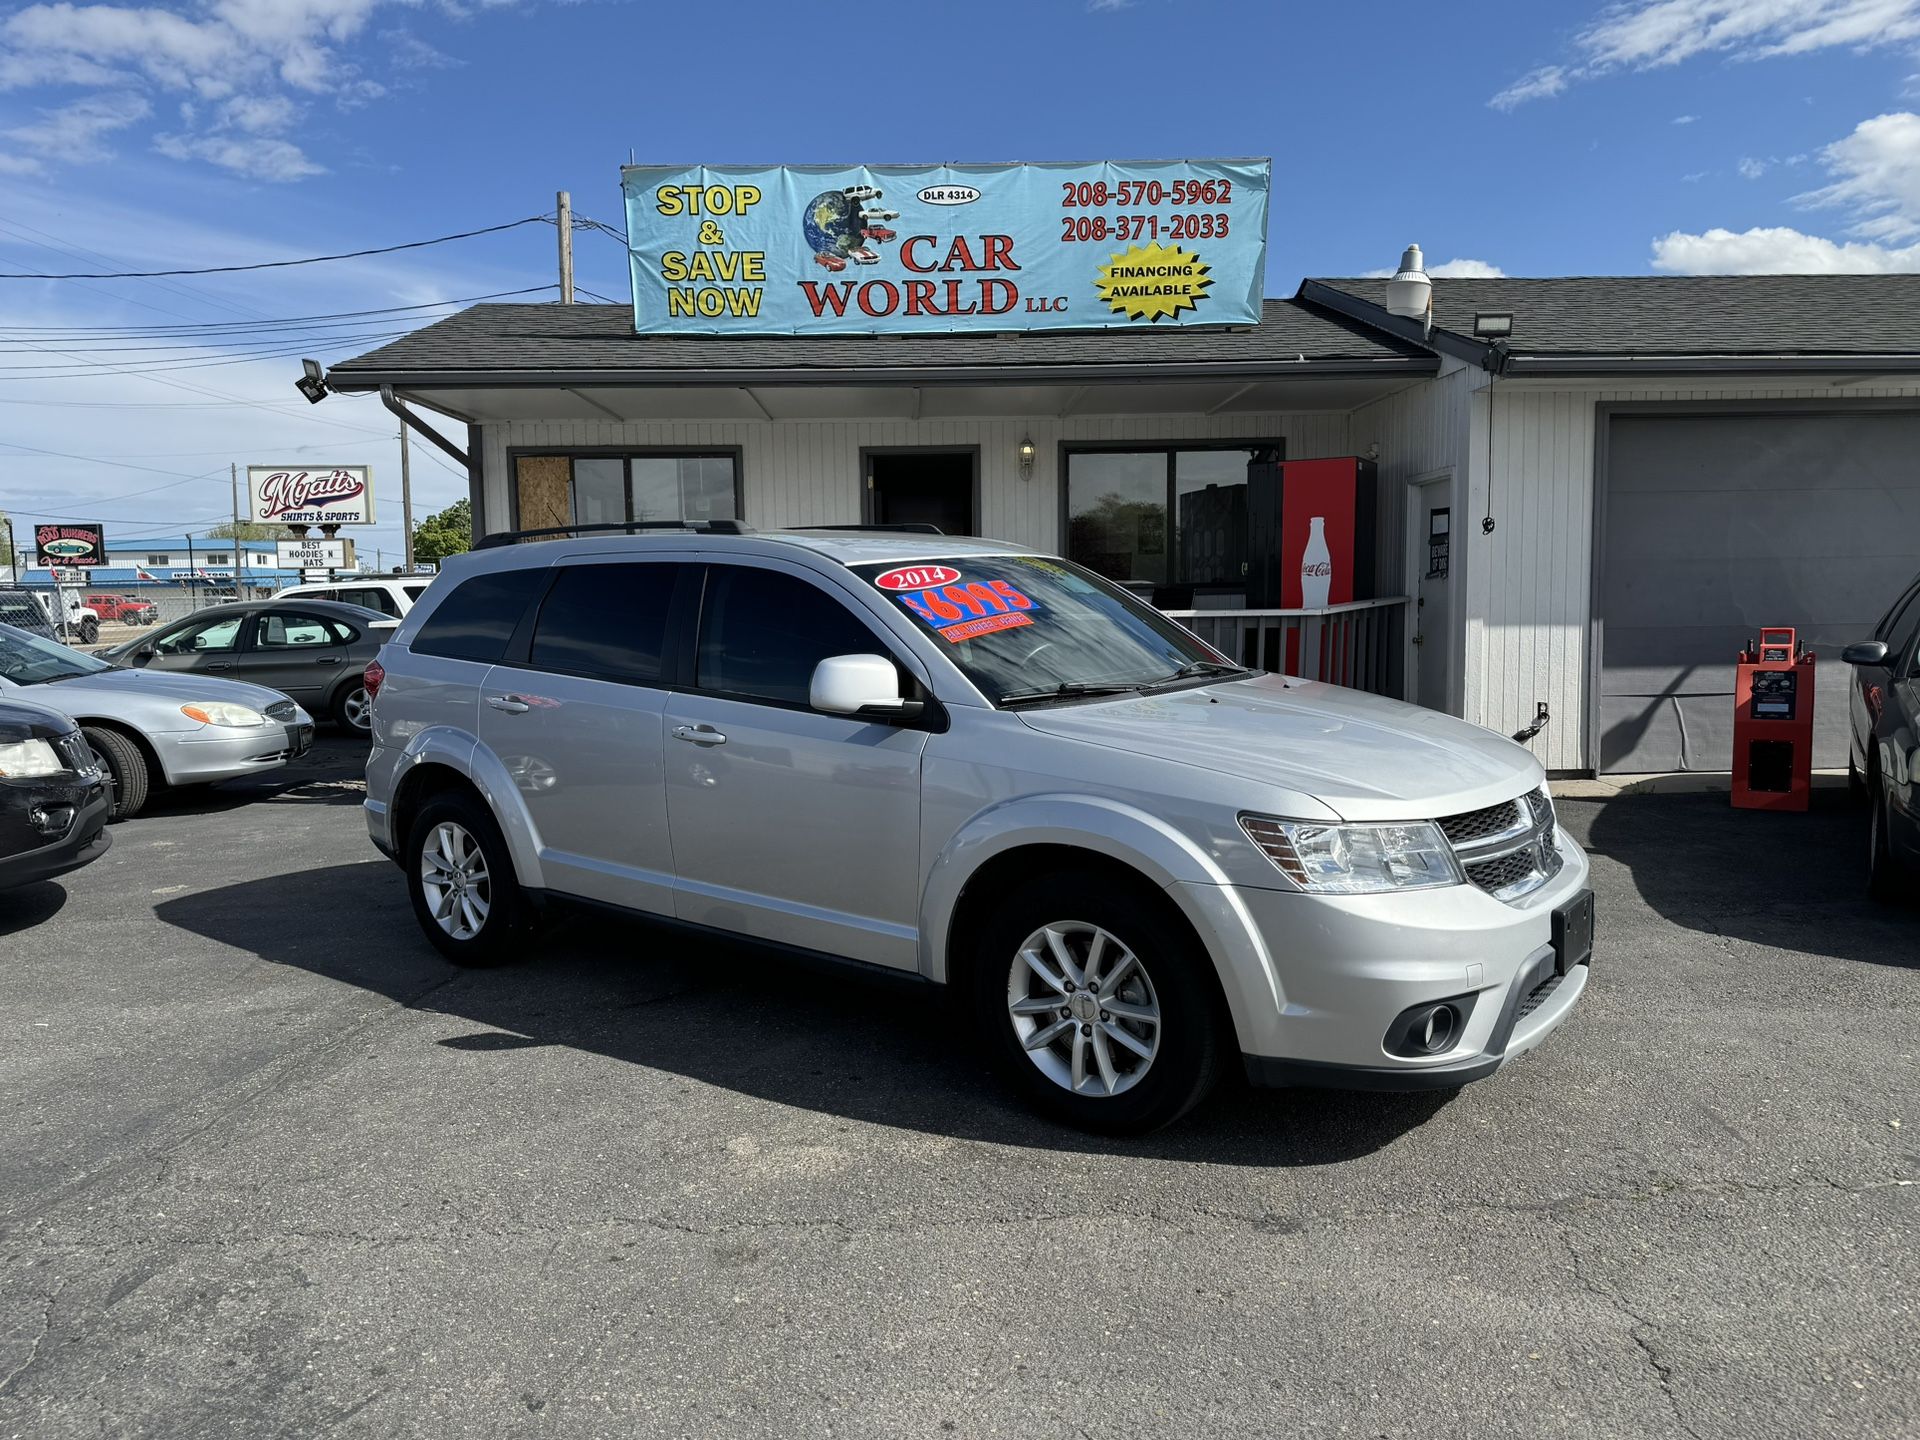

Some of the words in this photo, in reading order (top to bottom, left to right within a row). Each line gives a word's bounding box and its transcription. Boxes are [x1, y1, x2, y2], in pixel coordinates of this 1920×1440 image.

[656, 185, 761, 215] STOP
[923, 191, 945, 200] DLR
[947, 190, 974, 200] 4314
[1062, 179, 1232, 207] 208-570-5962
[698, 220, 724, 245] &
[1061, 213, 1229, 242] 208-371-2033
[899, 234, 1022, 273] CAR
[661, 251, 766, 281] SAVE
[1110, 265, 1193, 278] FINANCING
[668, 287, 763, 317] NOW
[797, 278, 1019, 318] WORLD
[1024, 296, 1069, 313] LLC
[1110, 284, 1192, 297] AVAILABLE
[280, 512, 315, 521] SHIRTS
[315, 511, 324, 522] &
[324, 512, 360, 521] SPORTS
[289, 550, 324, 558] HOODIES
[328, 550, 334, 558] N
[301, 541, 321, 549] BEST
[303, 559, 324, 567] HATS
[892, 567, 946, 588] 2014
[904, 580, 1031, 621] $6995
[966, 619, 998, 633] WHEEL
[1000, 612, 1026, 626] DRIVE
